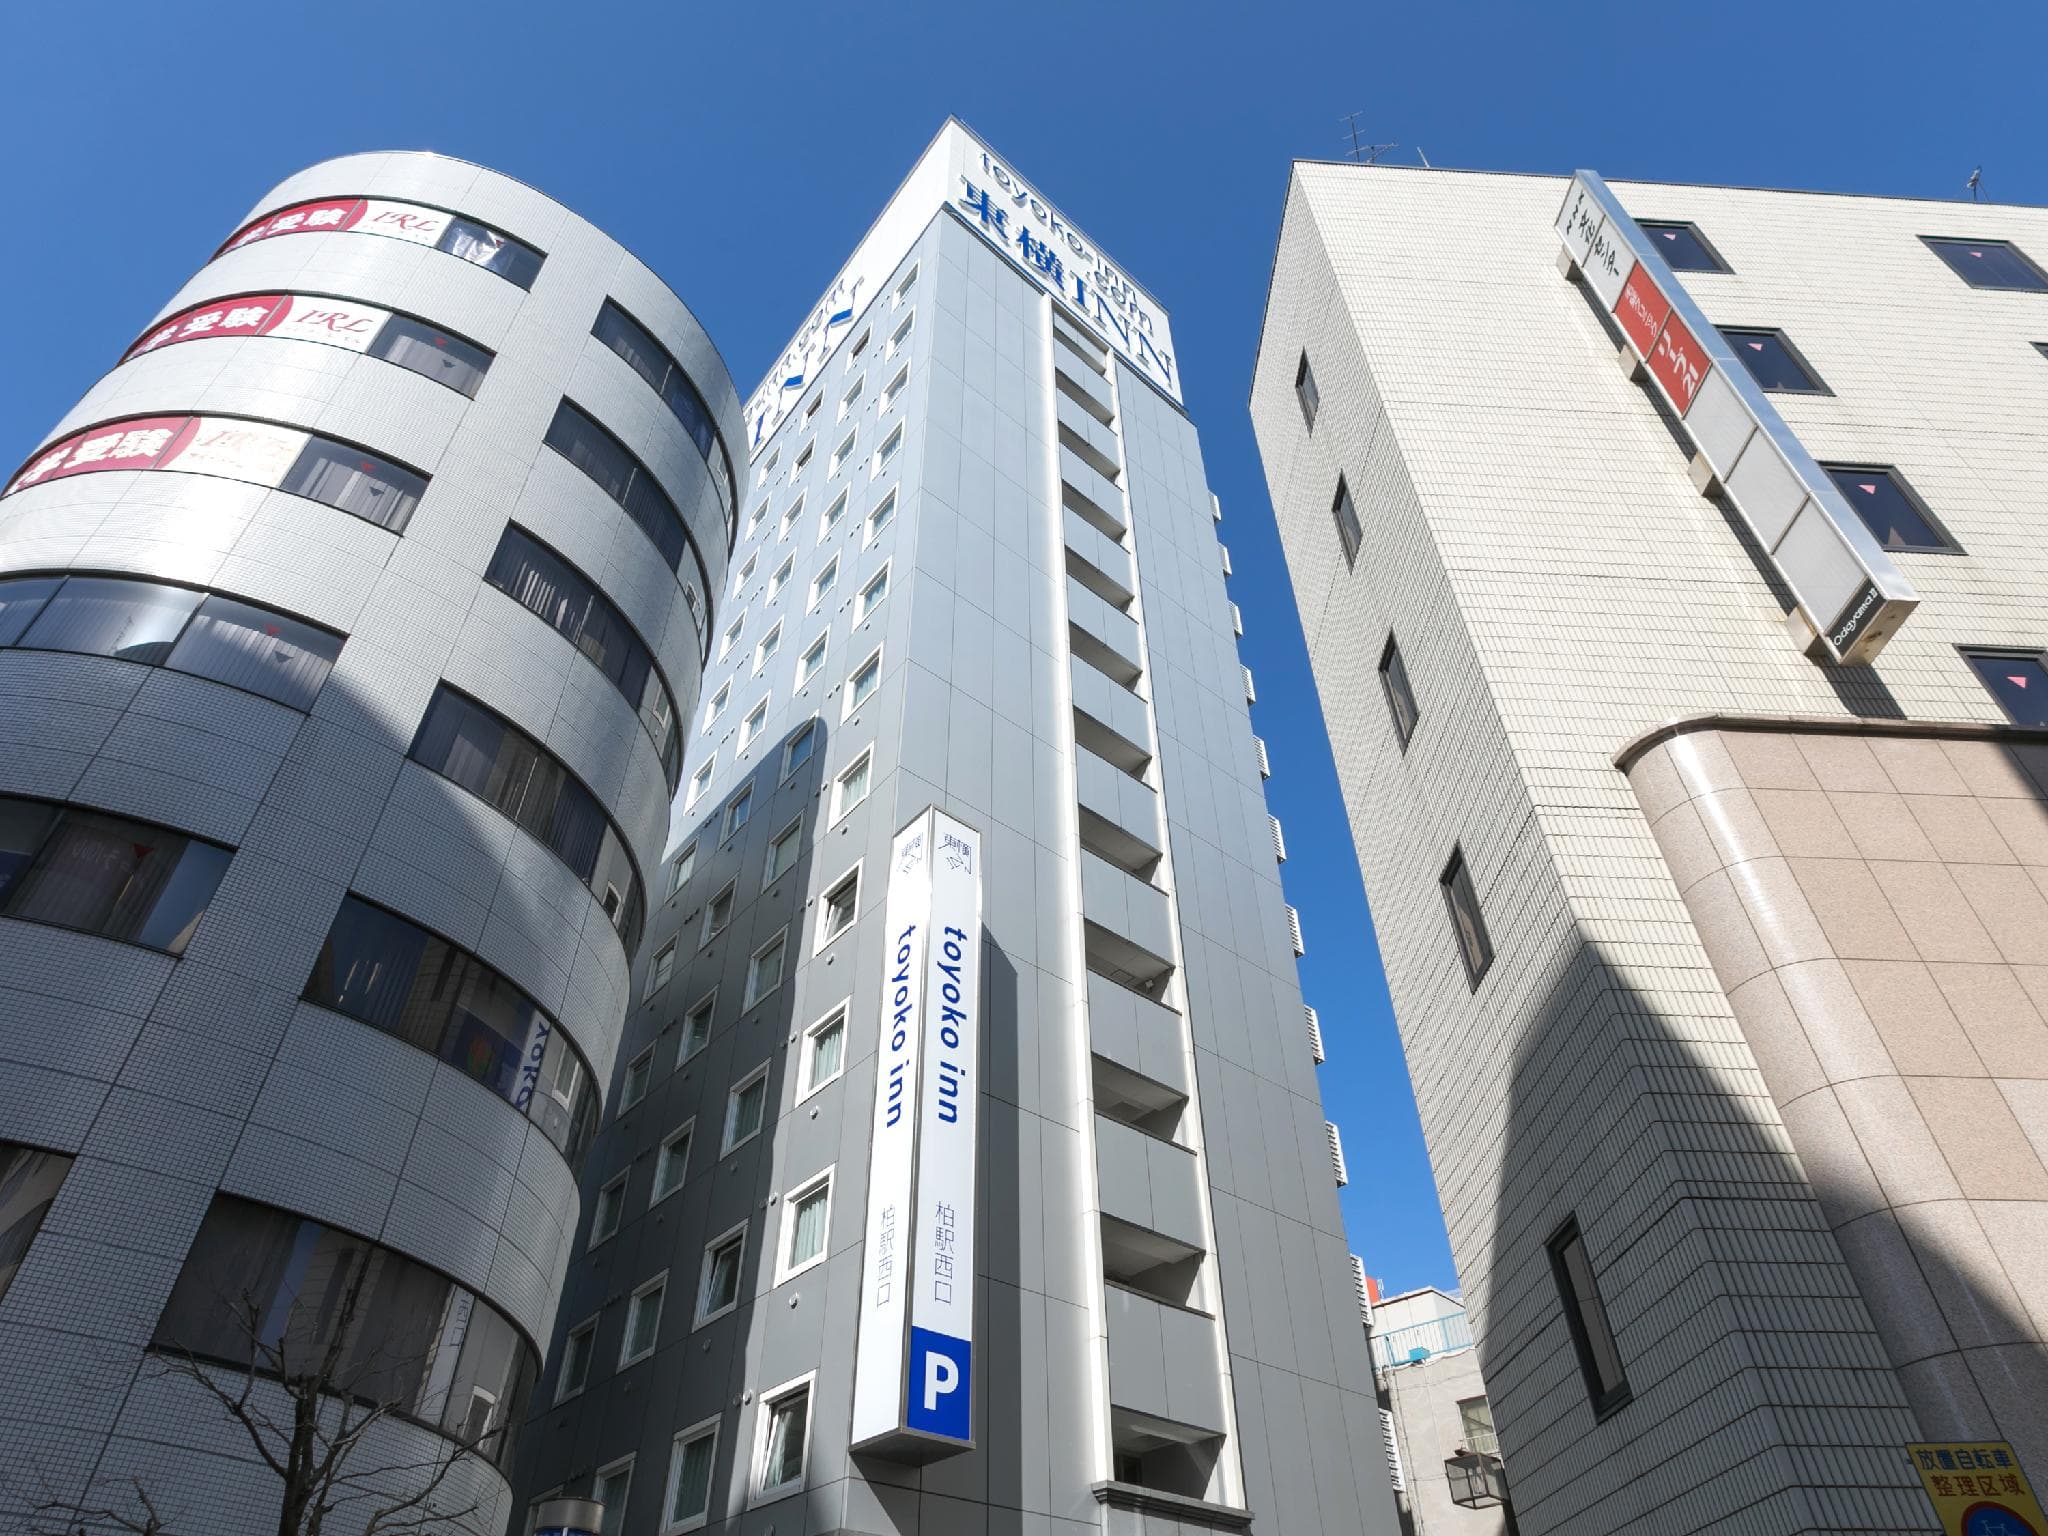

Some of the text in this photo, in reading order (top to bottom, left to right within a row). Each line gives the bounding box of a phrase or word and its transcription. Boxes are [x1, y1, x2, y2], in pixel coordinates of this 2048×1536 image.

[959, 175, 1173, 388] 東横INN
[1658, 329, 1699, 400] リーブ21
[886, 925, 916, 1128] toyoko inn
[937, 926, 967, 1124] toyoko inn
[876, 1204, 895, 1309] 柏駅西口
[935, 1200, 955, 1306] 柏駅西口
[924, 1351, 959, 1411] P
[1916, 1449, 2014, 1471] 放置自転車
[1931, 1473, 2026, 1497] 整理区域
